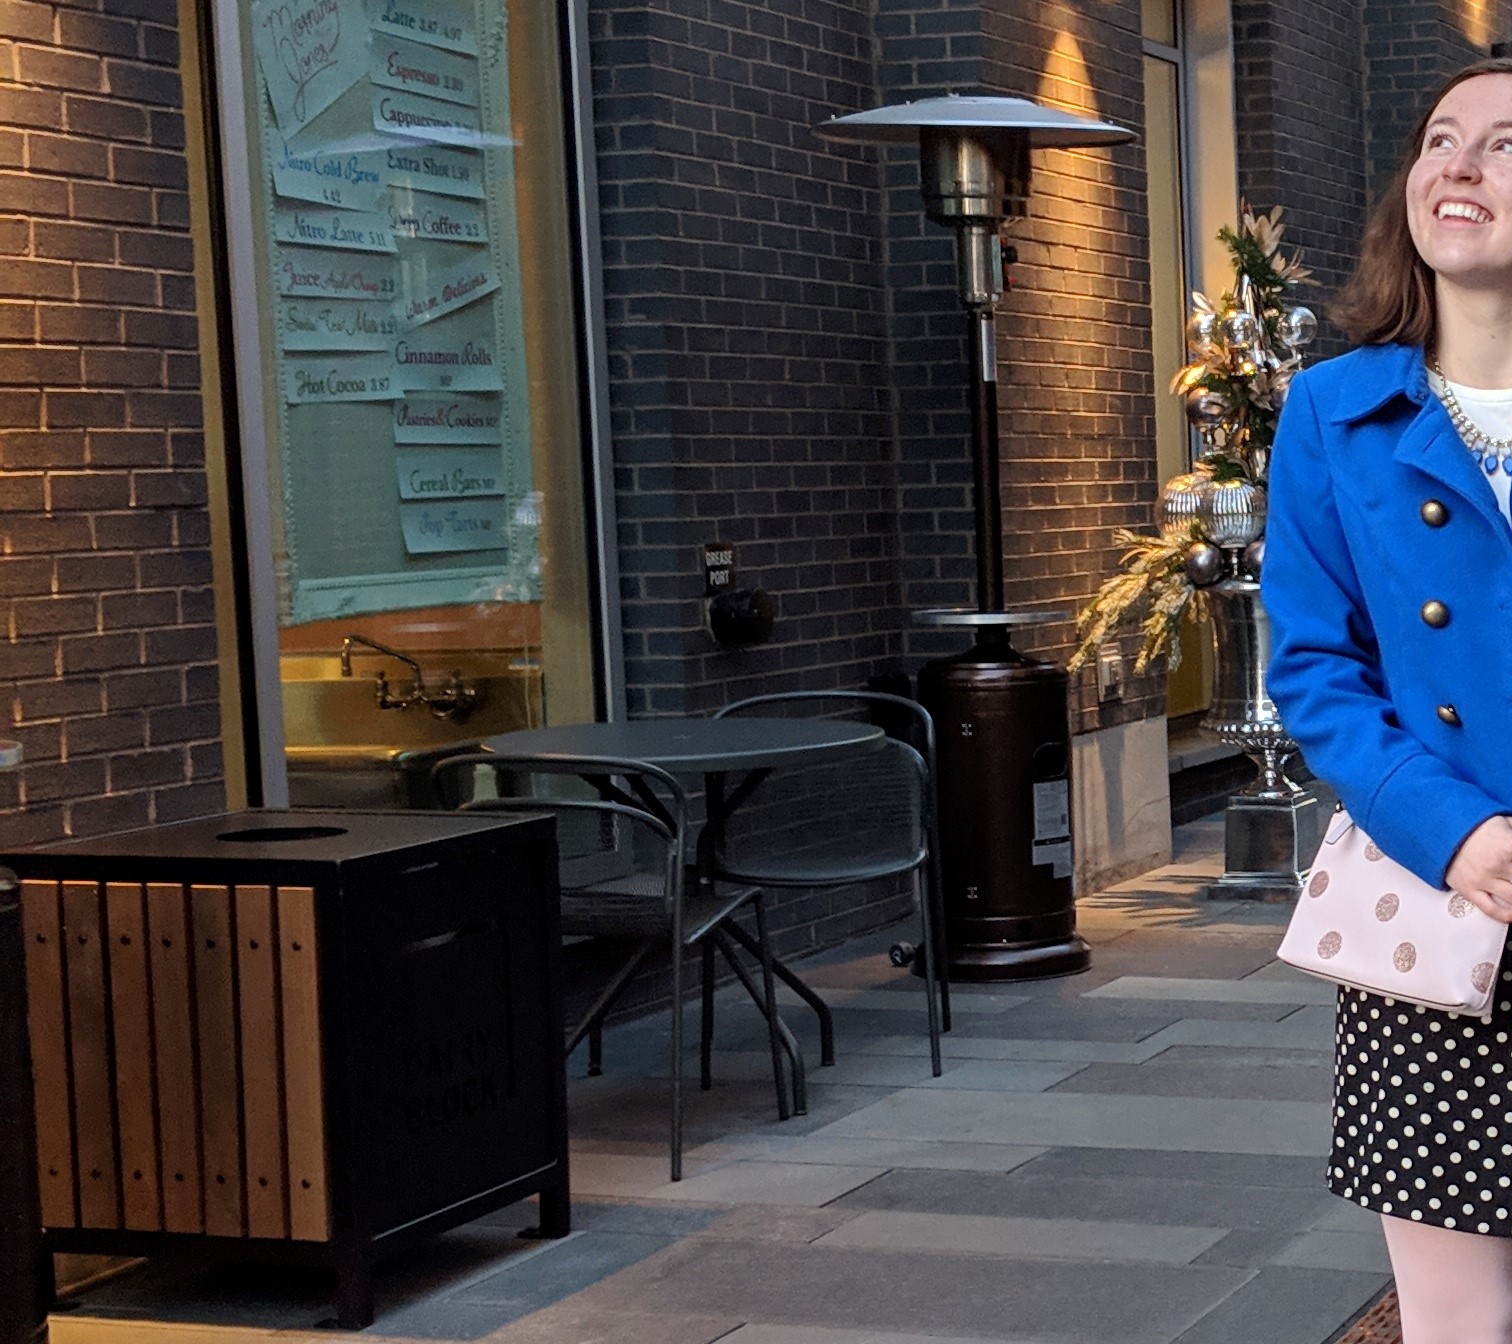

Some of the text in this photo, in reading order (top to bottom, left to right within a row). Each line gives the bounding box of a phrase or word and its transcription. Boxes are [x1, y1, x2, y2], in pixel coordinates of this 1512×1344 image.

[382, 0, 416, 30] Latte
[387, 52, 440, 86] Espresso
[313, 152, 341, 177] Cold
[344, 156, 379, 185] Brew
[387, 148, 420, 172] Extra
[422, 157, 449, 177] Shot
[288, 214, 326, 240] Nitro
[330, 217, 364, 243] Latte
[422, 210, 462, 236] Coffee
[396, 340, 493, 366] Cinnamon Rolls
[295, 370, 324, 397] Hot
[326, 369, 366, 395] Cocoa
[410, 468, 449, 494] Cereal
[452, 467, 481, 495] Bars
[705, 550, 733, 567] GREASE
[710, 569, 730, 586] PORT
